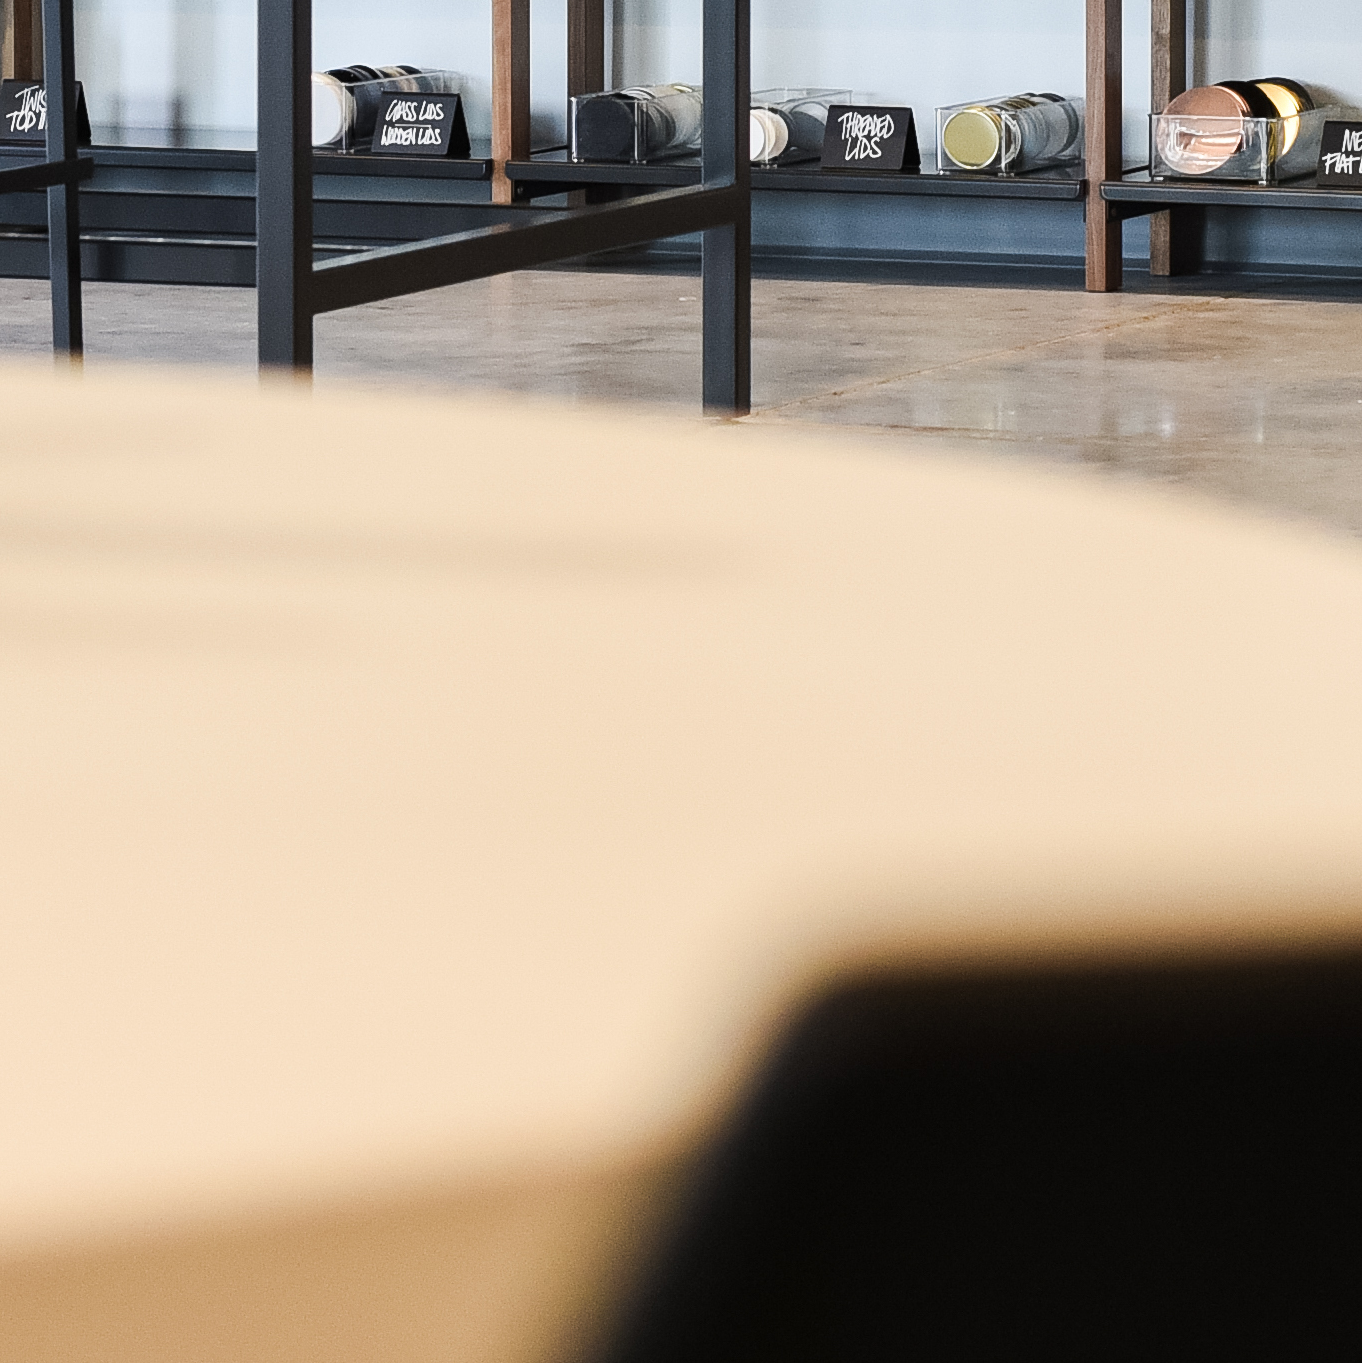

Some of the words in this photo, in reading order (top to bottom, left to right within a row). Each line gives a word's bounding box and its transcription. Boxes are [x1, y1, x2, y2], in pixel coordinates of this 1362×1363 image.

[838, 112, 895, 140] THREADED
[845, 137, 882, 161] LIDS
[1322, 152, 1360, 175] FLAT
